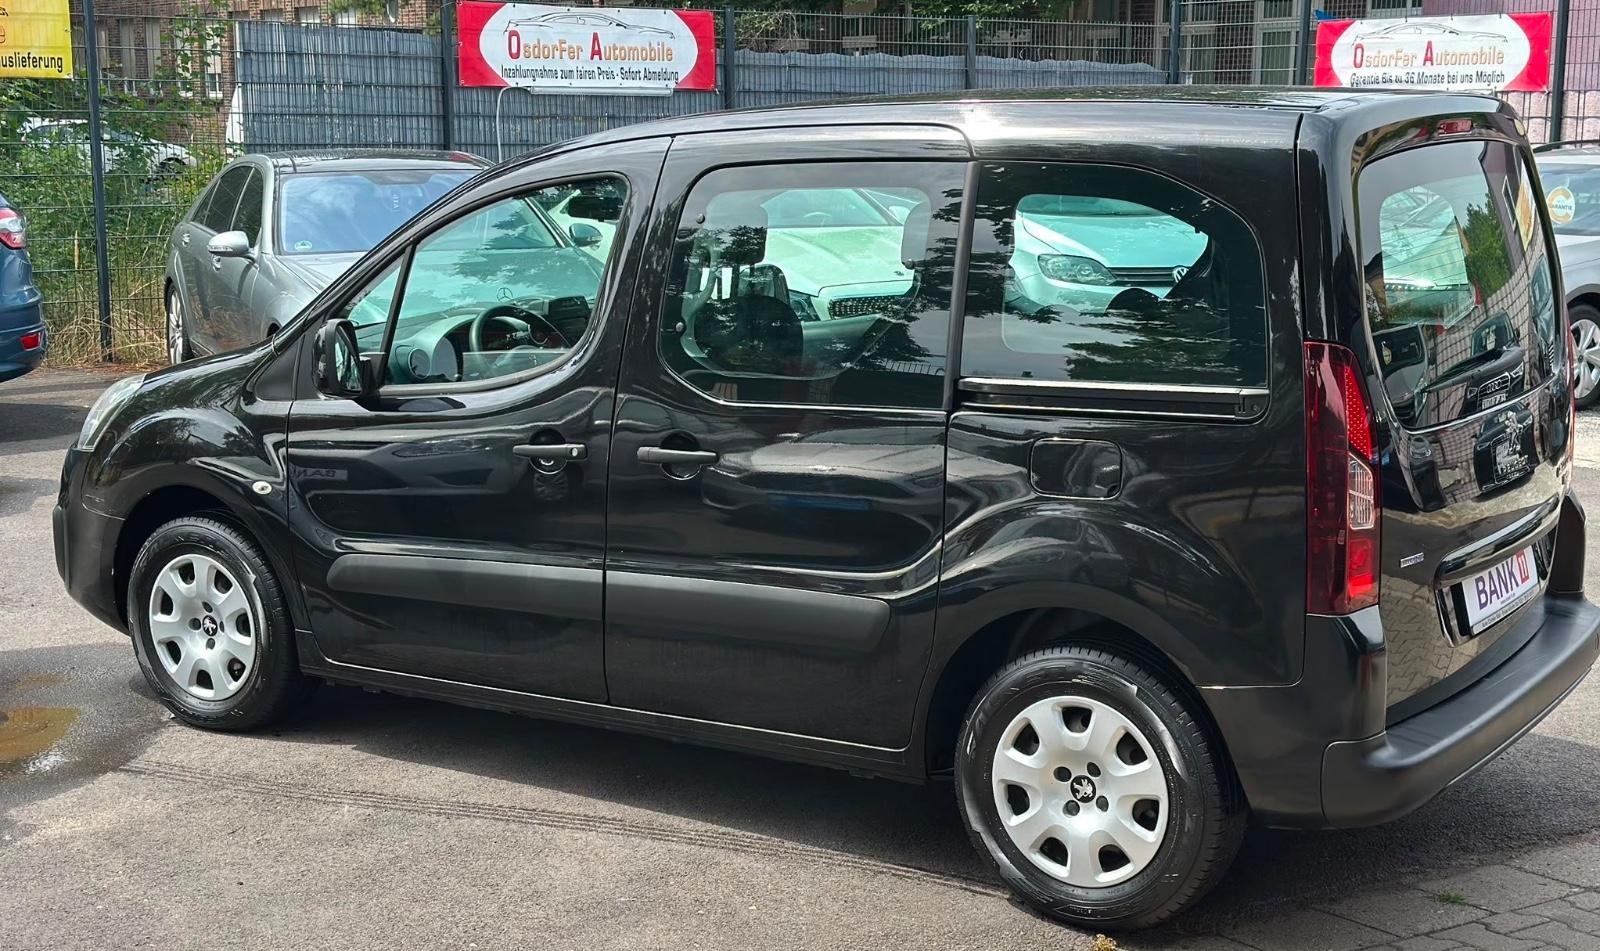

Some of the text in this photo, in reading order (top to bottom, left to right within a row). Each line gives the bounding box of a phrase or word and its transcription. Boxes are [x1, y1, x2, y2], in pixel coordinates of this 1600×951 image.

[590, 32, 673, 61] Automobile
[1423, 40, 1504, 66] Automobile
[501, 65, 558, 82] Inzahlungnahme
[560, 69, 575, 80] zum
[576, 66, 596, 80] fairen
[597, 66, 615, 80] Preis
[620, 67, 641, 81] Sofort
[643, 67, 678, 85] Abmeldung
[1351, 73, 1380, 87] Garantie
[1404, 71, 1415, 84] 36
[1417, 71, 1445, 85] Monate
[1447, 71, 1458, 84] bei
[1460, 74, 1473, 84] uns
[1475, 70, 1505, 86] Möglich
[1475, 557, 1519, 610] BANK
